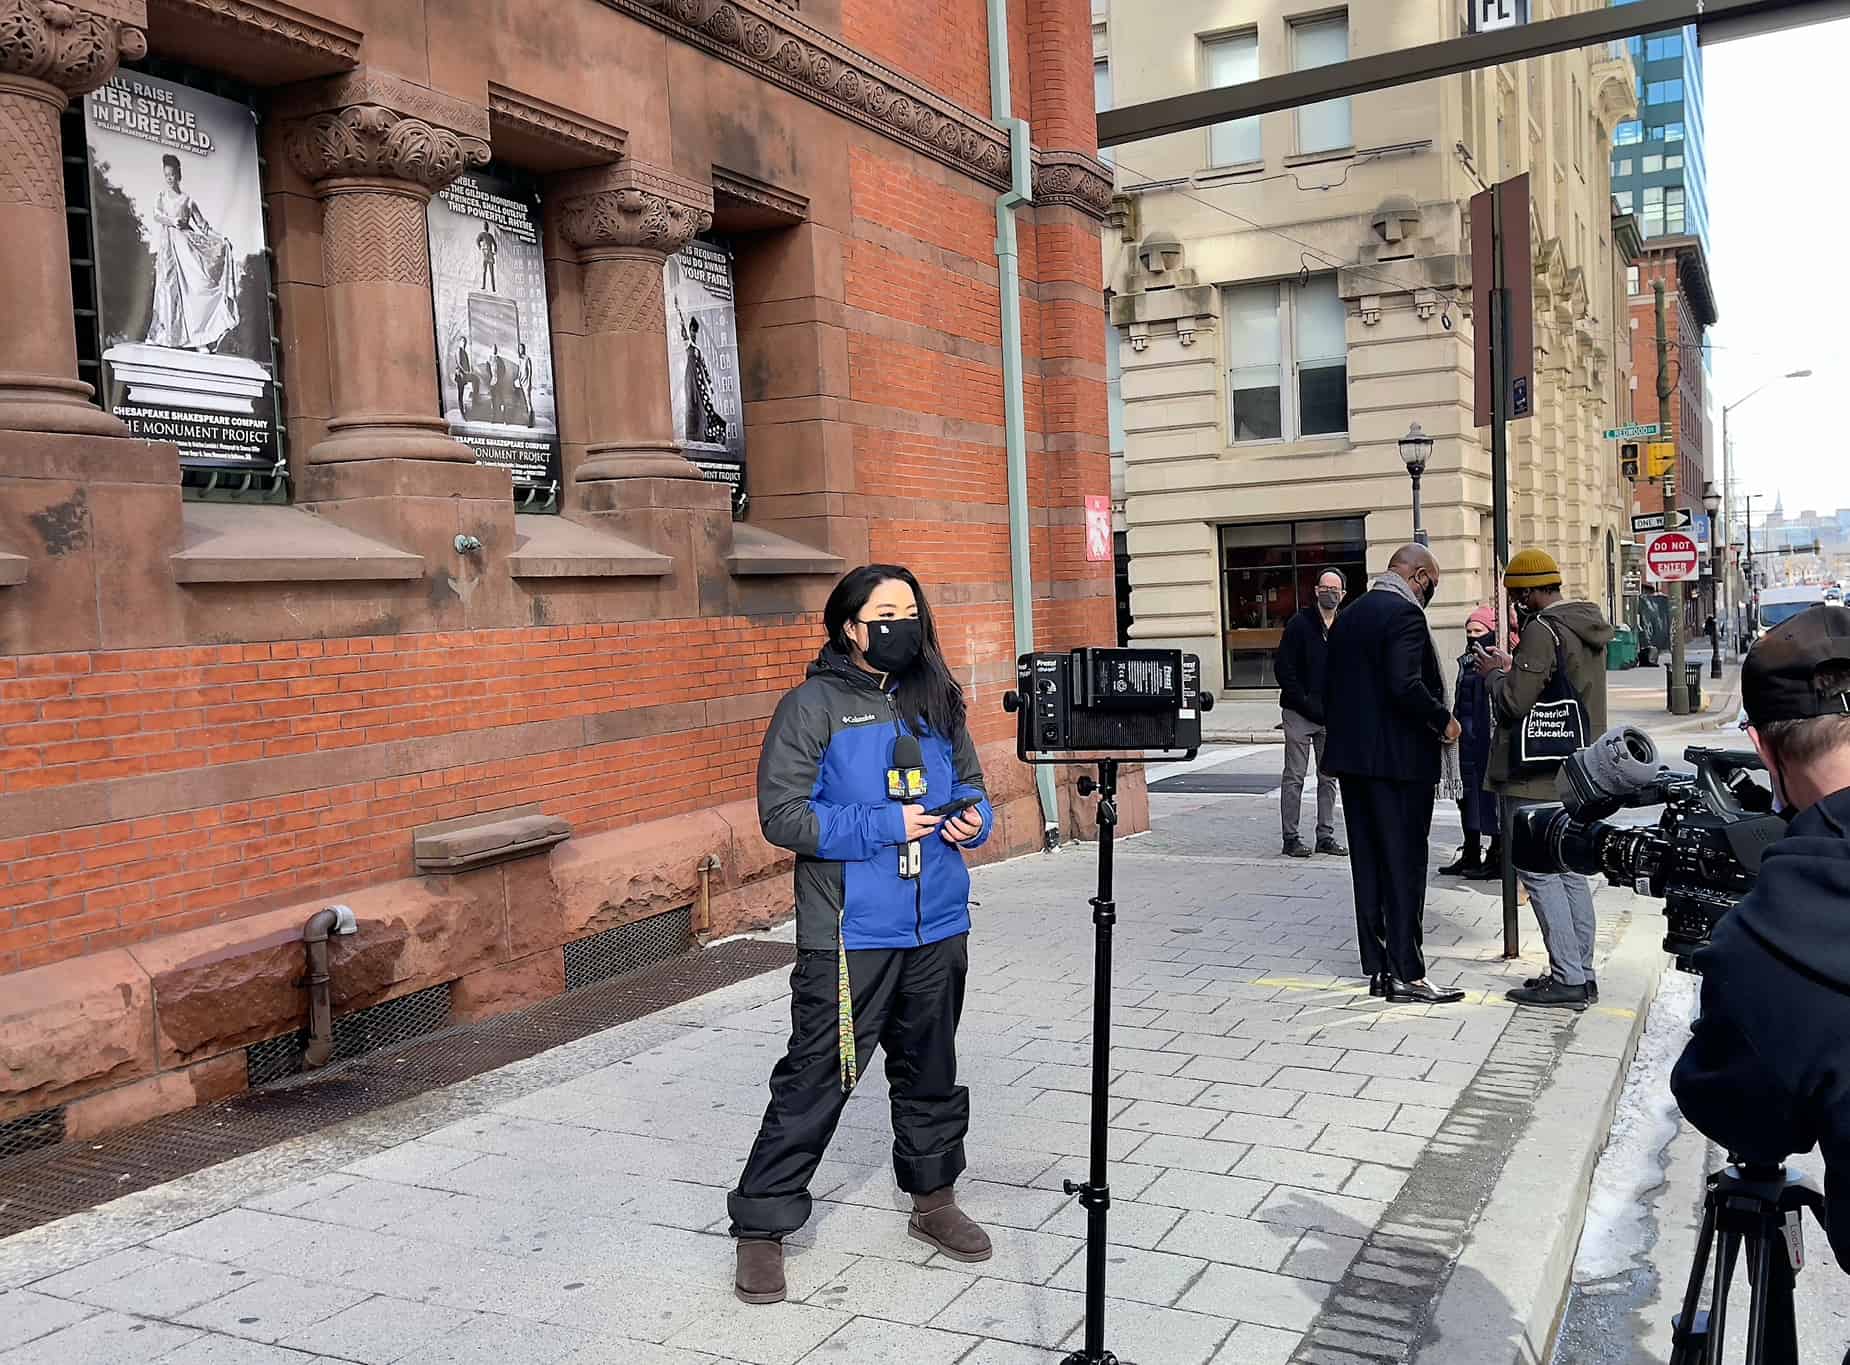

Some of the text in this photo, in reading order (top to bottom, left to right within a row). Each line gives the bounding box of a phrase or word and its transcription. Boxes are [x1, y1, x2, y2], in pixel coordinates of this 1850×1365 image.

[133, 81, 173, 105] RAISE
[91, 85, 196, 129] HER STATUE
[92, 104, 215, 152] IN PURE GOLD.
[439, 190, 450, 200] OF
[450, 183, 465, 195] THE
[448, 200, 466, 214] THIS
[467, 205, 508, 225] POWERFUL
[680, 255, 692, 266] YOU
[692, 258, 704, 268] DO
[683, 266, 706, 281] YOUR
[113, 406, 268, 429] CHESAPEAKE SHAKESPEARE COMPANY
[143, 422, 219, 440] MONUMENT
[222, 428, 270, 444] PROJECT
[519, 450, 552, 464] PROJECT
[1654, 541, 1690, 551] DO NOT
[1657, 562, 1687, 573] ENTER
[1527, 726, 1575, 738] Education
